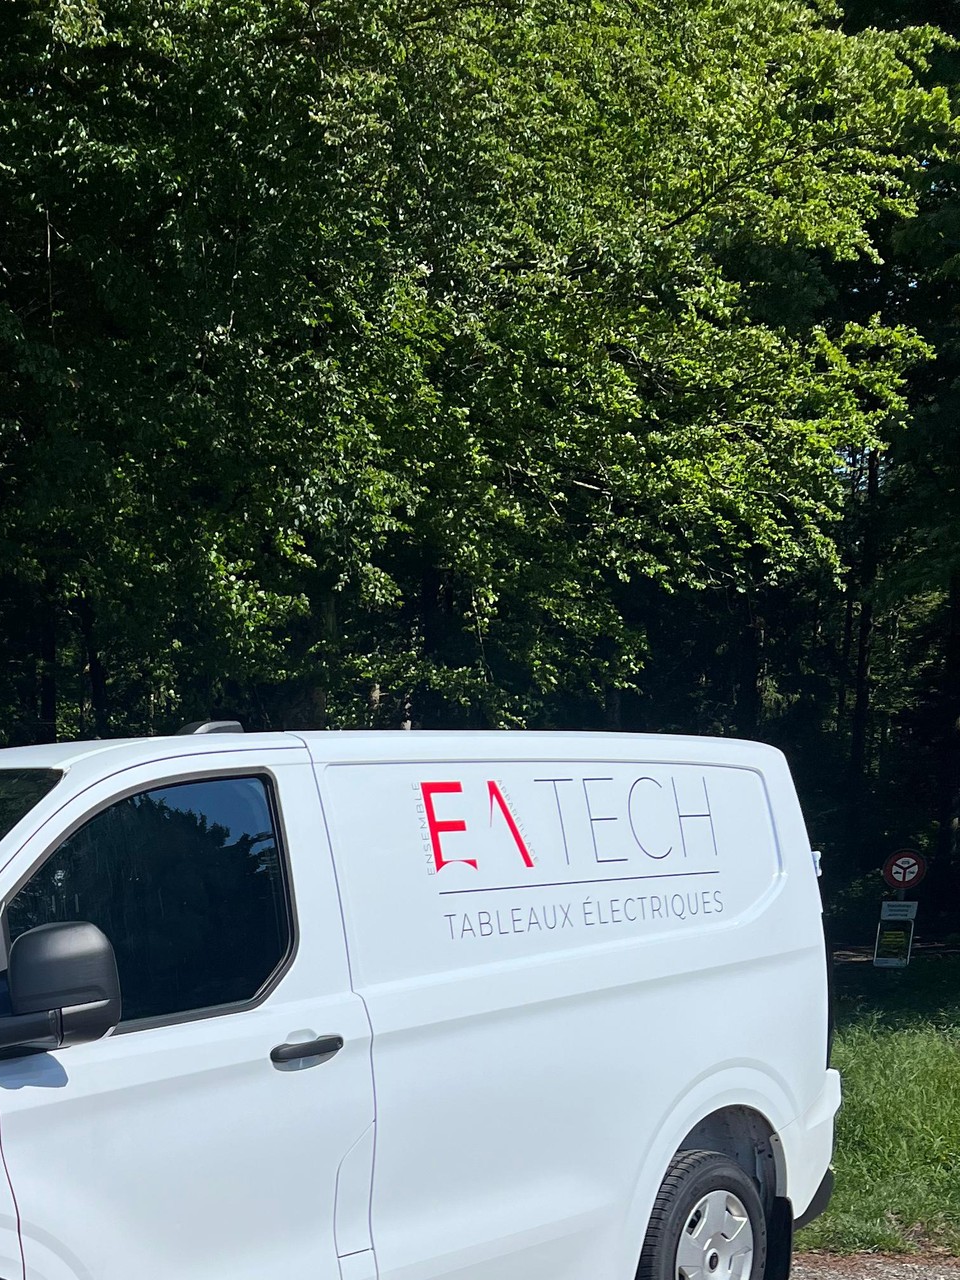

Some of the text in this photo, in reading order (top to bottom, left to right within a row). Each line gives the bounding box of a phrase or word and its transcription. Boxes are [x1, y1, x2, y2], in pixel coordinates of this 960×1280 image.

[411, 783, 436, 876] ENSEMBLE
[444, 891, 724, 939] TABLEAUX ÉLECTRIQUES
